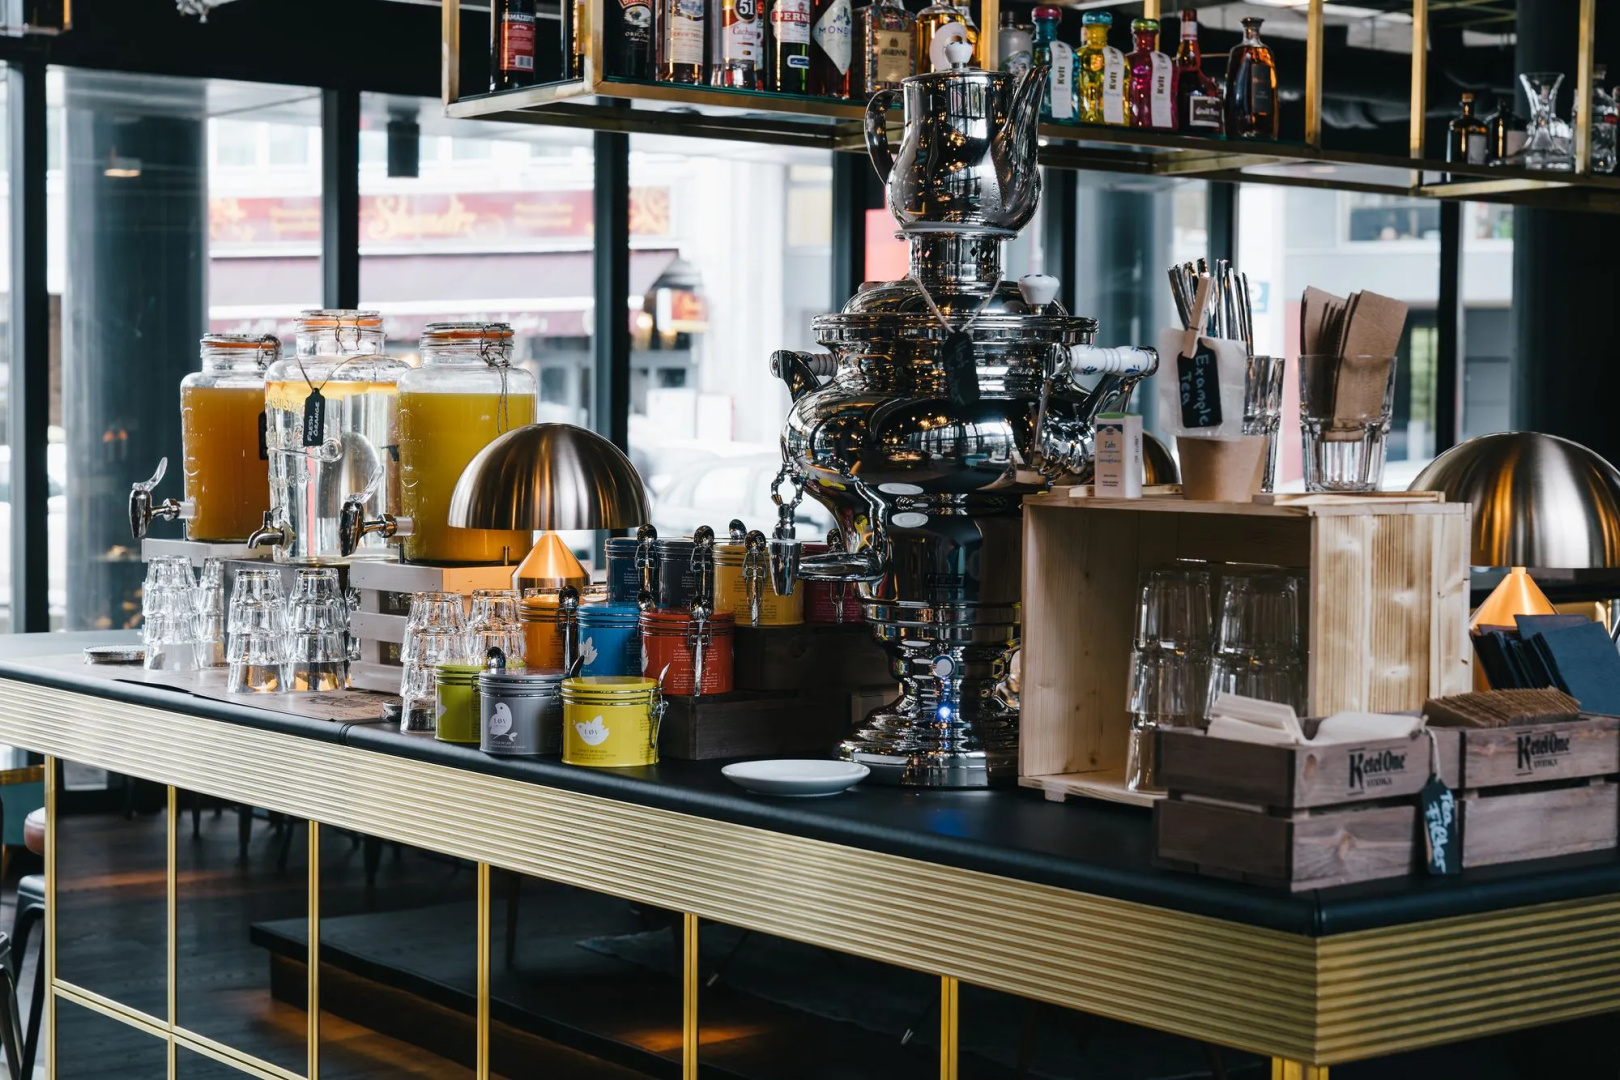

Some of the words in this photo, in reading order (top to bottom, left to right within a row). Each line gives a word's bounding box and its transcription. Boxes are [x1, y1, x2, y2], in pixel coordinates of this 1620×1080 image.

[739, 0, 754, 15] 51
[1180, 371, 1193, 406] Tea
[1193, 354, 1211, 426] Example
[1348, 752, 1383, 790] Ketel
[1383, 750, 1405, 772] One
[1516, 735, 1549, 771] Ketel
[1549, 731, 1570, 753] One
[1440, 790, 1454, 827] Tea
[1425, 801, 1448, 873] Filter
